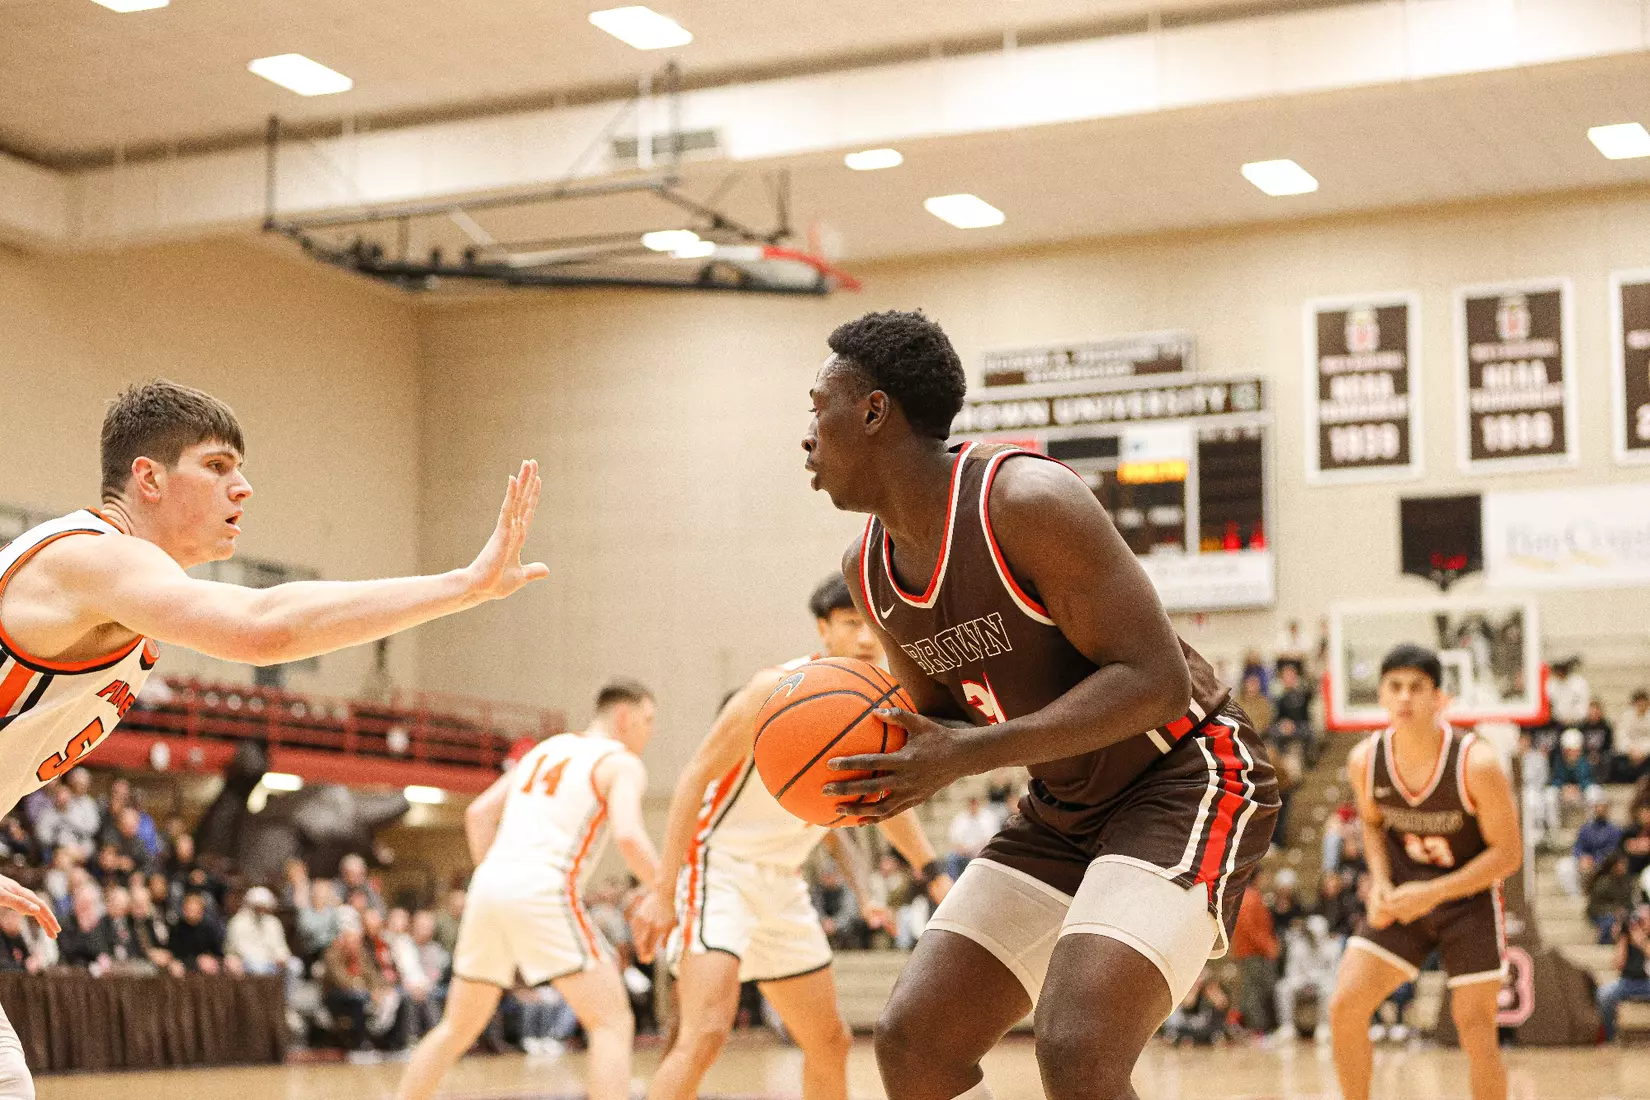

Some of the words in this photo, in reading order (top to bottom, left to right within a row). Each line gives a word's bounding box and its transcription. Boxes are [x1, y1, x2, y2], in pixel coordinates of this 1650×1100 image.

[900, 612, 1013, 675] BROWN
[36, 715, 104, 782] 5
[520, 753, 572, 797] 14
